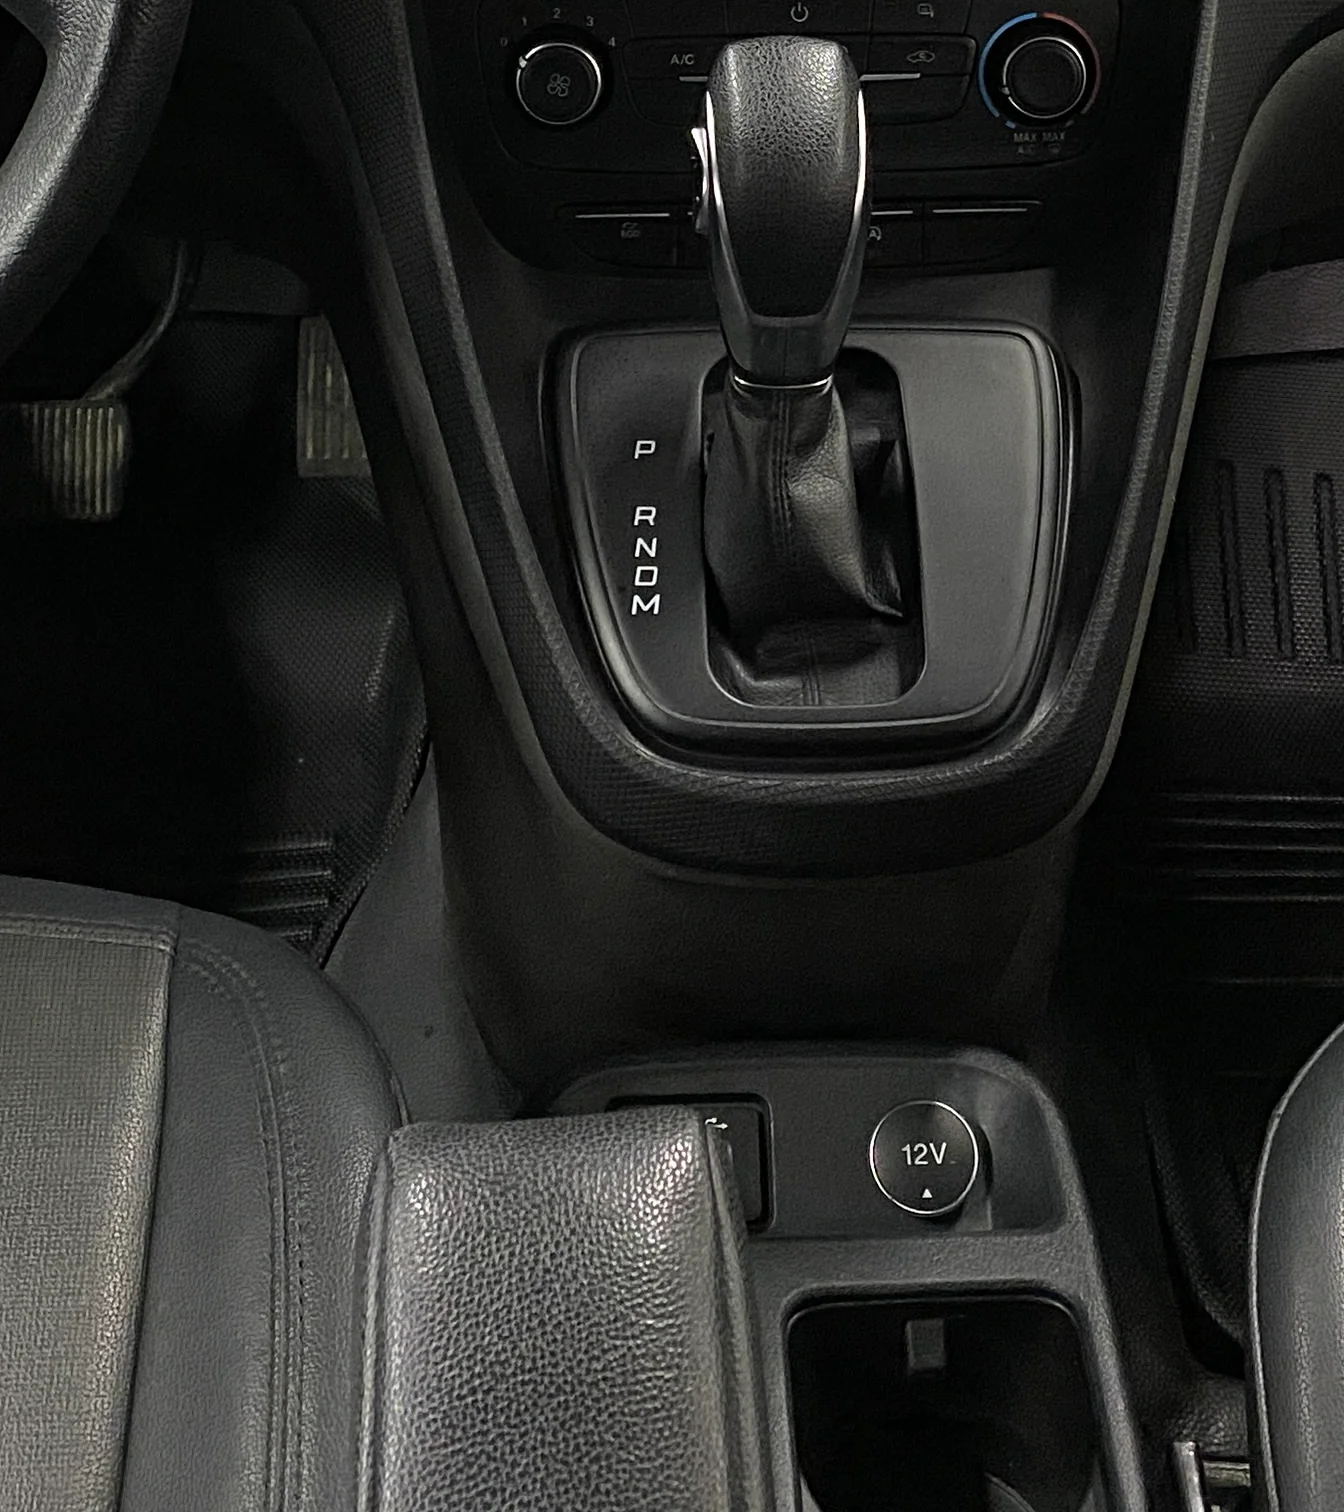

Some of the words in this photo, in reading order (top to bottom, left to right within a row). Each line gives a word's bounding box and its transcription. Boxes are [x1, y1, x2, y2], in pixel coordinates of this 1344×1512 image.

[553, 8, 561, 19] 2
[586, 16, 595, 27] 3
[608, 37, 616, 48] 4
[670, 53, 696, 66] A/C
[1013, 132, 1037, 143] MAX
[634, 440, 656, 459] P
[633, 506, 657, 526] R
[634, 537, 657, 558] N
[634, 565, 659, 587] D
[631, 593, 661, 615] M
[901, 1141, 947, 1166] 12V
